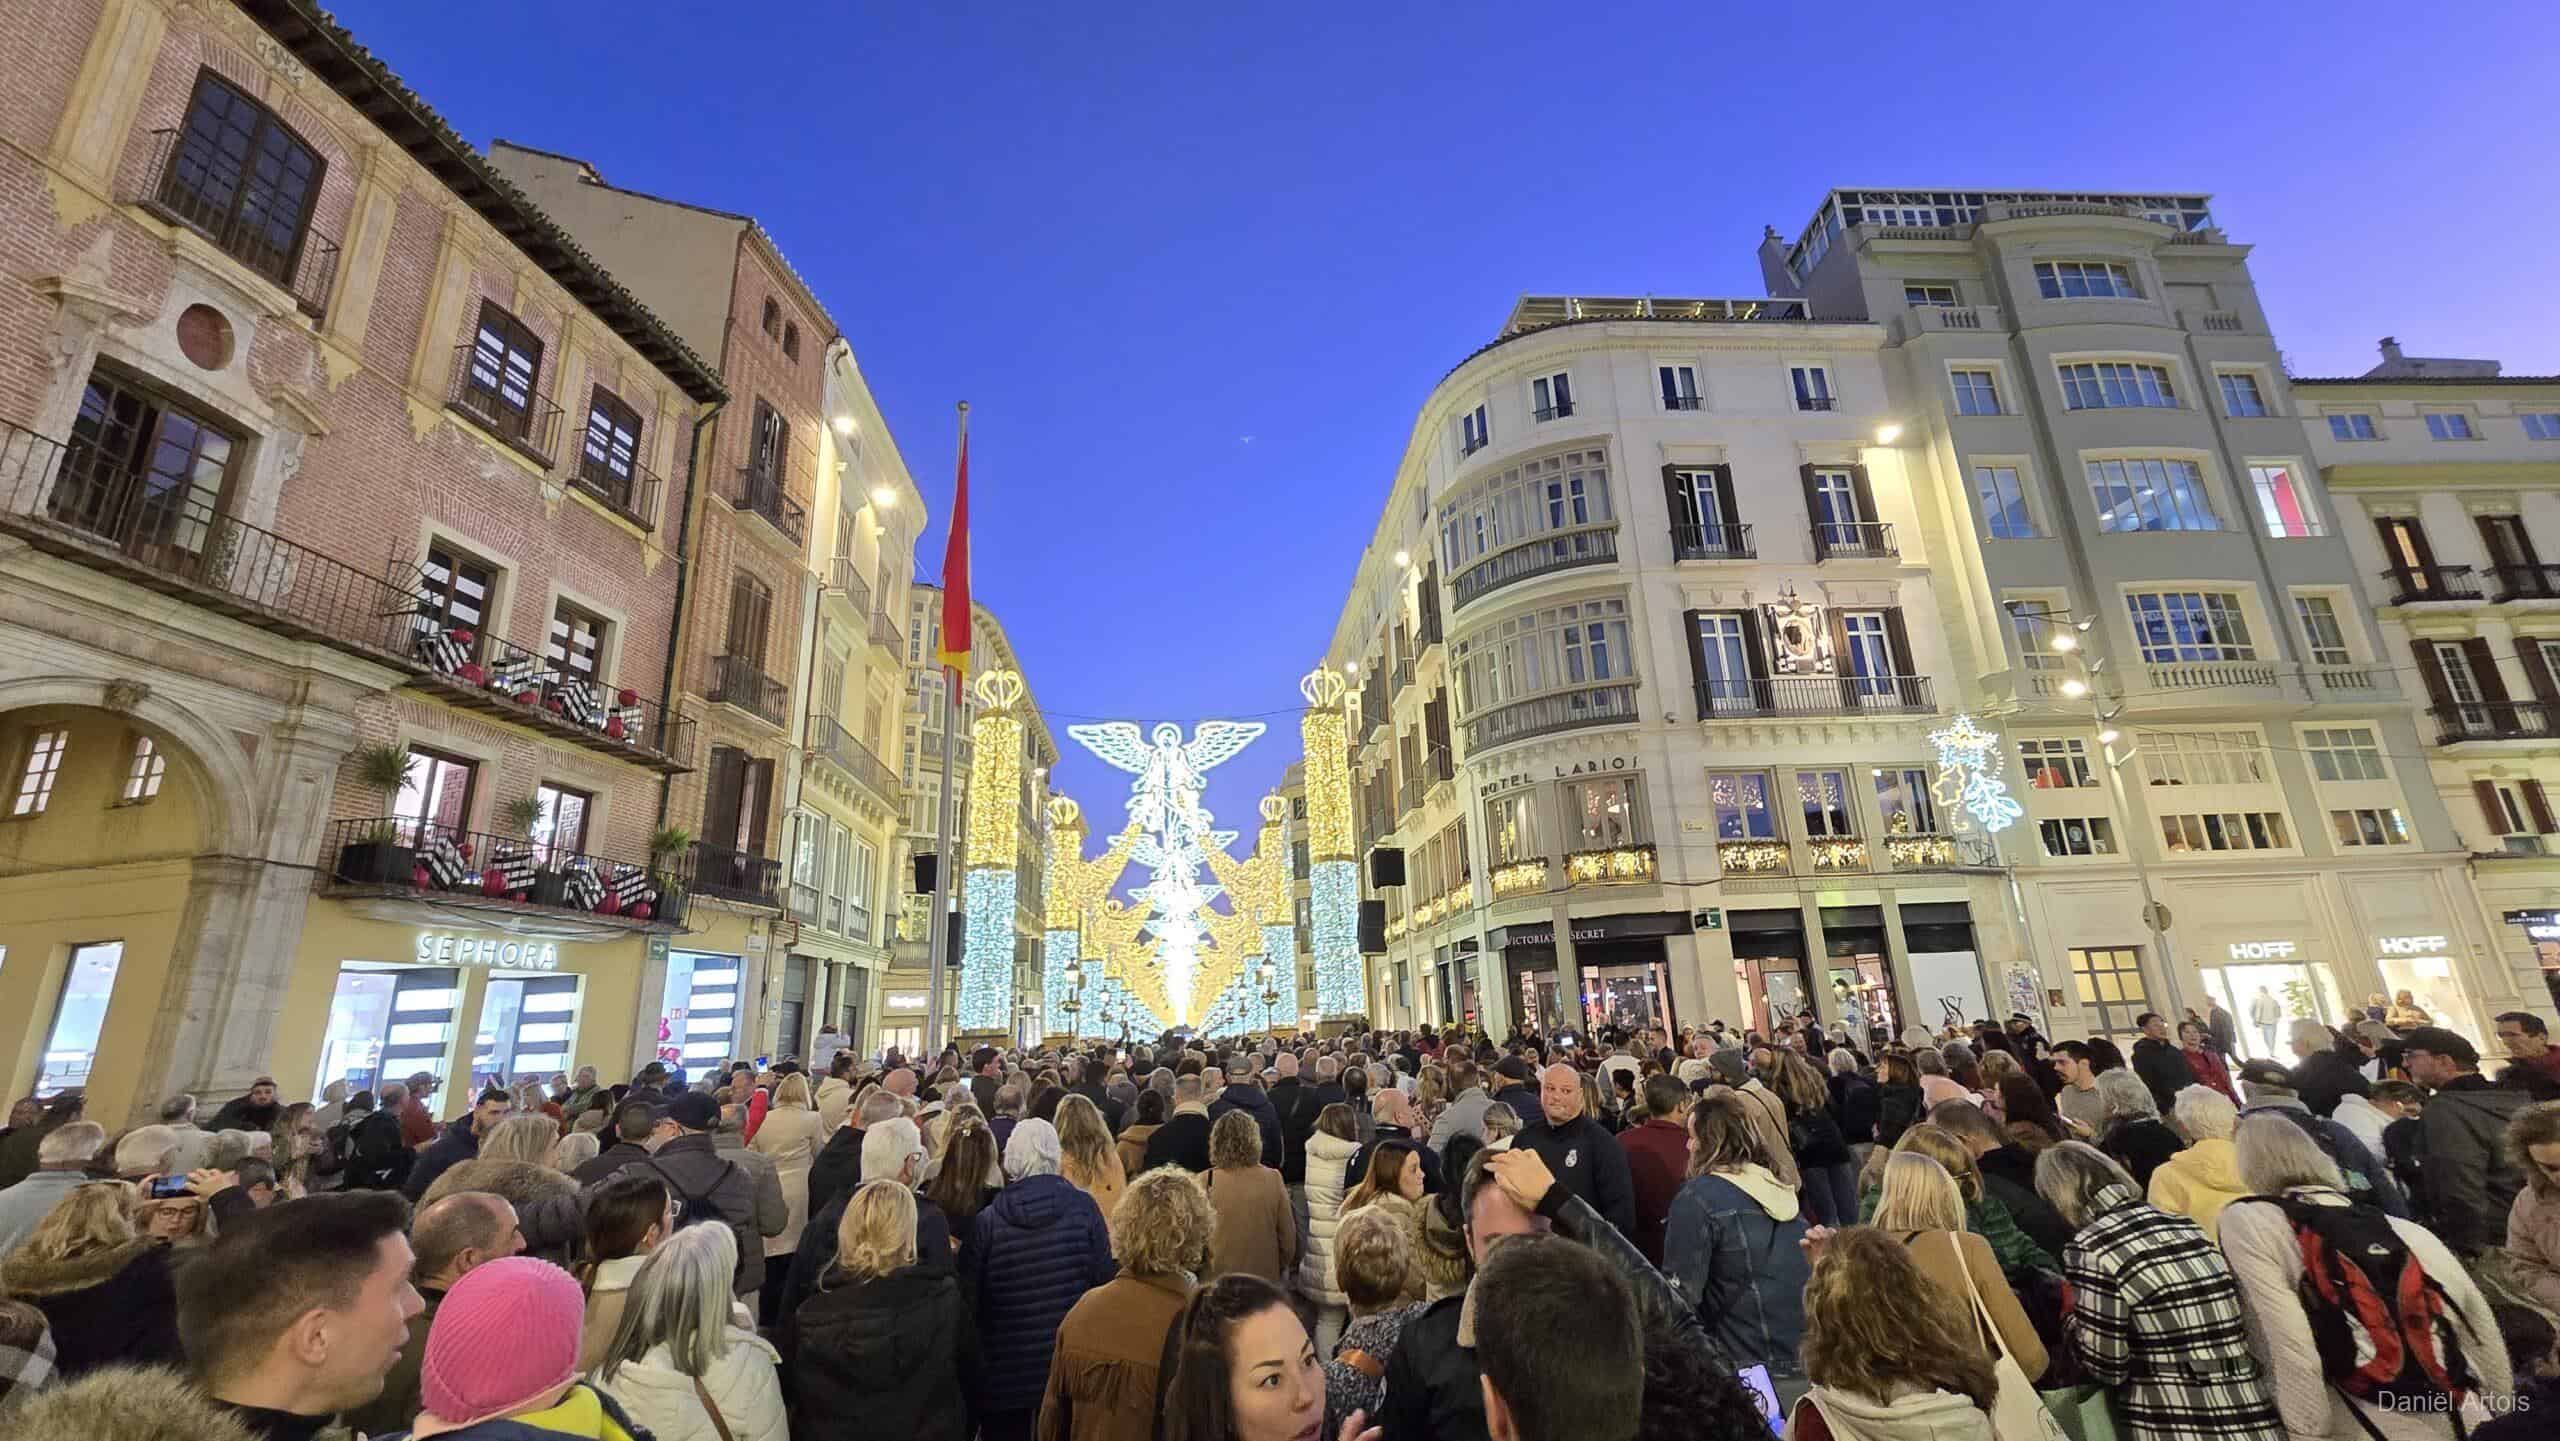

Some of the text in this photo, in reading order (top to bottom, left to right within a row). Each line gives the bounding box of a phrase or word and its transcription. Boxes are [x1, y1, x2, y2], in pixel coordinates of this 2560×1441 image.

[1570, 928, 1606, 941] SECRET
[416, 934, 557, 969] SEPHORA
[2229, 941, 2297, 960] HOFF
[2379, 935, 2447, 954] HOFF
